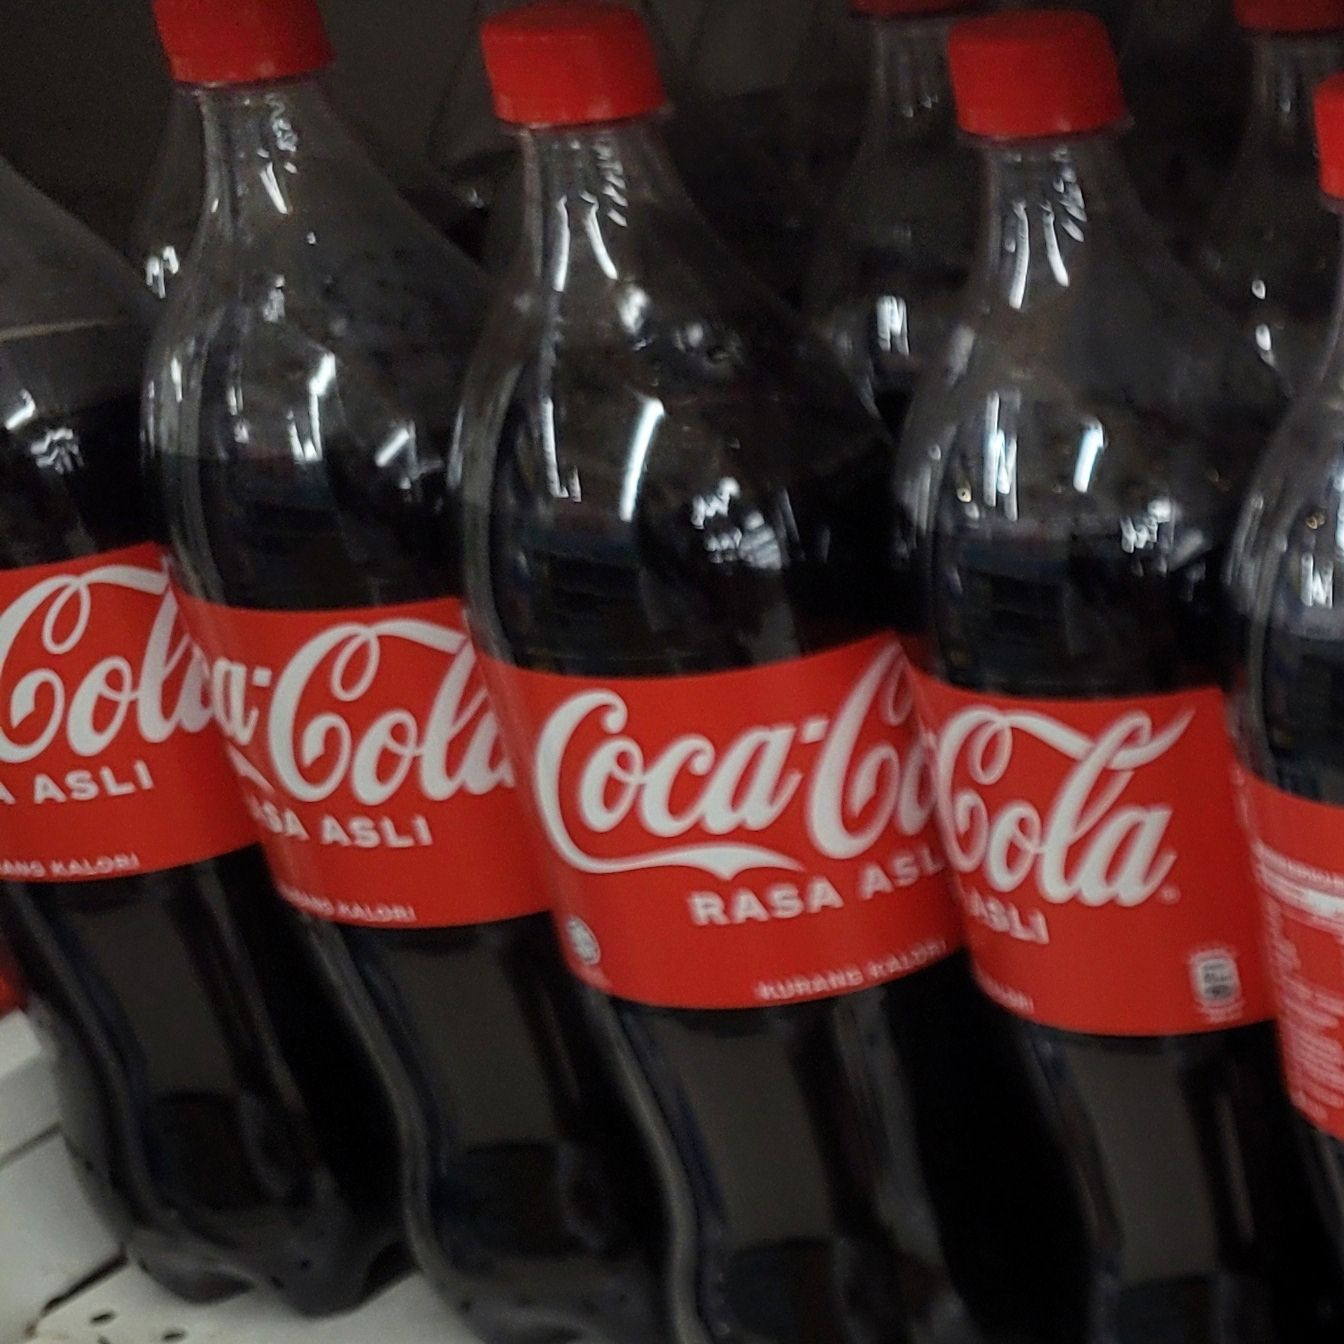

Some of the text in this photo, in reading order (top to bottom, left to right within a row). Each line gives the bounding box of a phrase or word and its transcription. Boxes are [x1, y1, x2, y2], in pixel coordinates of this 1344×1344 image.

[33, 760, 154, 804] ASLI
[320, 814, 433, 848] ASLI
[688, 844, 946, 926] RASA ASL
